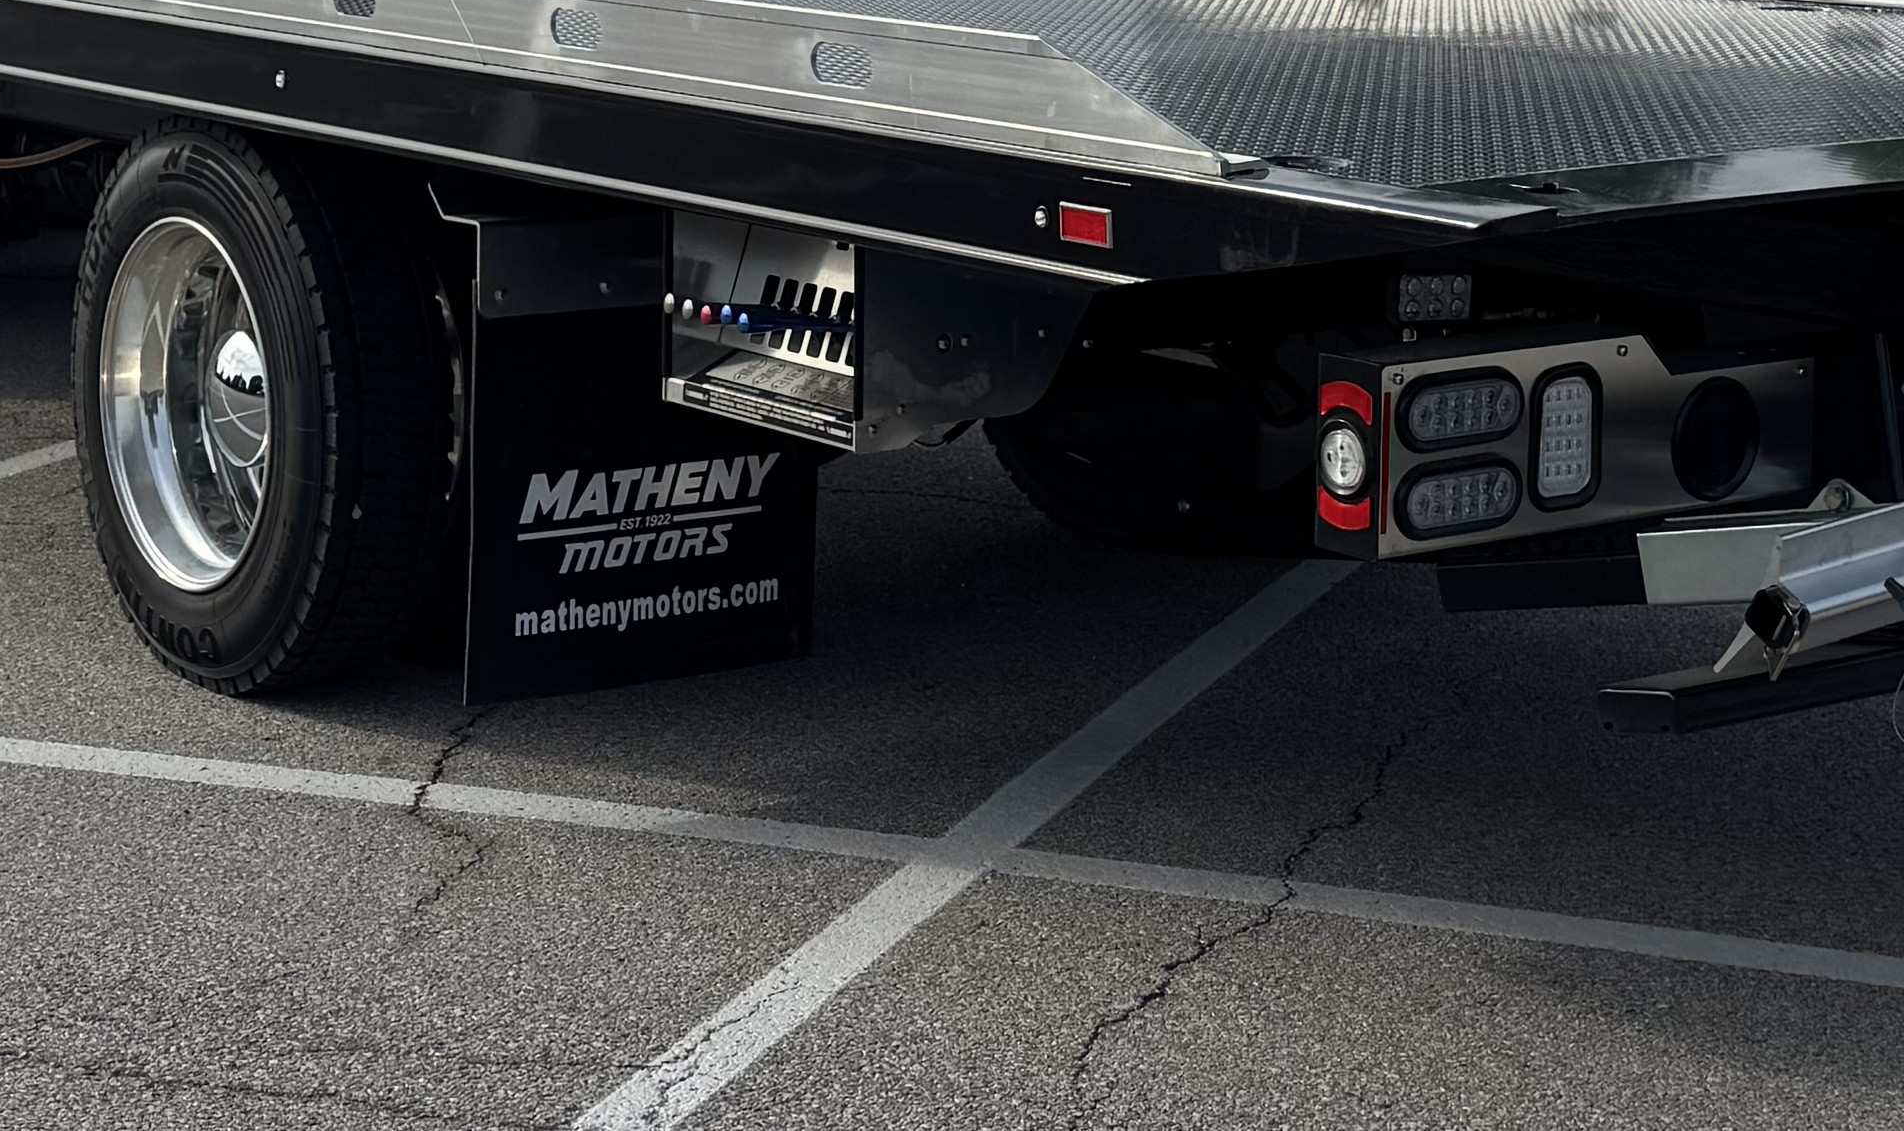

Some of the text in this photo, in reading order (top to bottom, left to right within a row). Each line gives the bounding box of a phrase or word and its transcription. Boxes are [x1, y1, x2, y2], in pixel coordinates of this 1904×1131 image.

[518, 451, 781, 525] MATHENY
[558, 522, 734, 574] MOTORS
[619, 512, 672, 530] EST. 1922
[514, 577, 779, 637] mathenymotors.com
